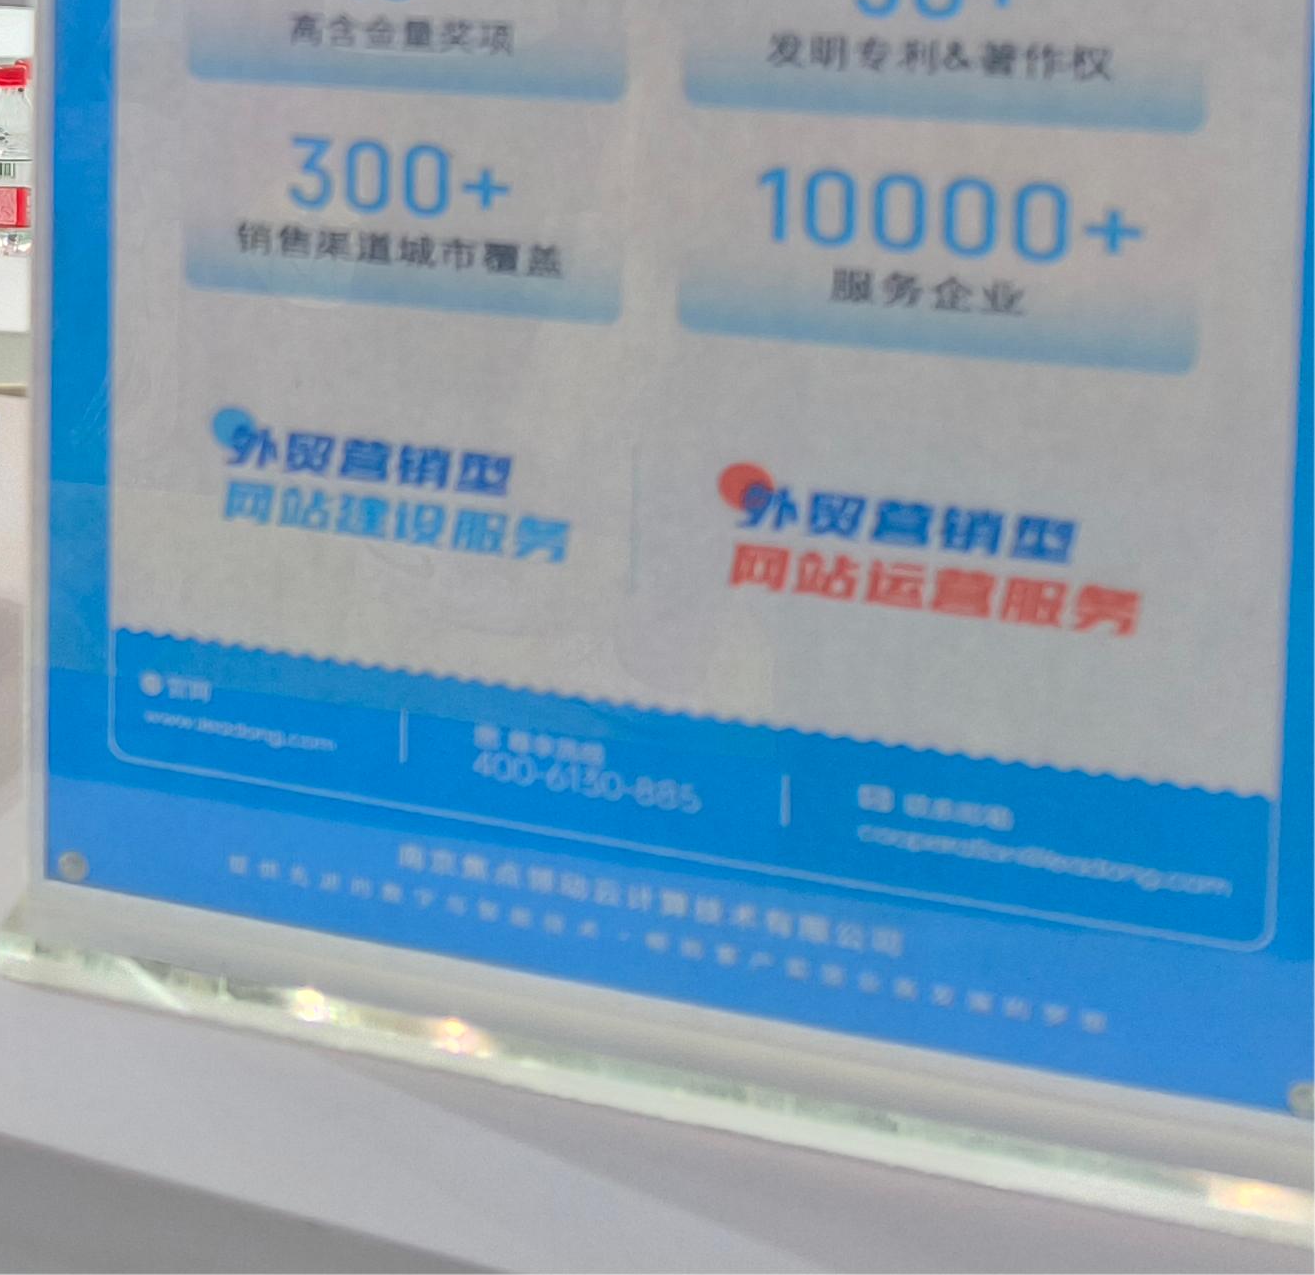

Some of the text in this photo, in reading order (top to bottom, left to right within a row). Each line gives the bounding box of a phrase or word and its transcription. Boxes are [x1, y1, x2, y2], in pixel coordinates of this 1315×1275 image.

[767, 32, 1116, 82] 发明专利&著作权
[287, 135, 511, 218] 300+
[758, 166, 1144, 265] 10000+
[236, 221, 565, 280] 销售渠道城市覆盖
[829, 267, 1027, 317] 服务企业
[226, 424, 514, 497] 外贸营销型
[222, 479, 572, 564] 网站建设服务
[736, 481, 1079, 566] 外贸营销型
[729, 541, 1142, 638] 网站运营服务
[473, 750, 703, 815] 400-6130-885
